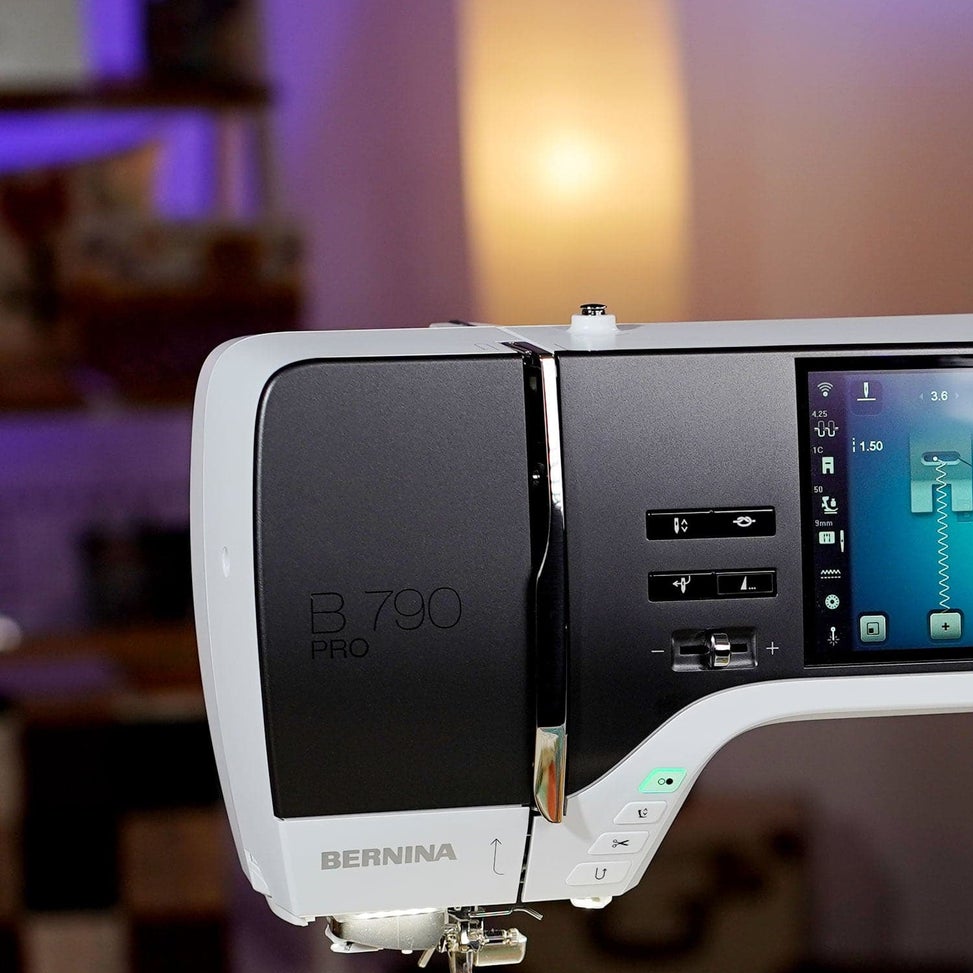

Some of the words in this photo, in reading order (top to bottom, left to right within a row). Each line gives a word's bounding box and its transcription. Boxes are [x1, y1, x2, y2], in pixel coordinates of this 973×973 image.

[930, 390, 949, 401] 3.6
[812, 410, 828, 418] 4.25
[812, 446, 824, 454] 1C
[860, 440, 883, 451] 1.50
[815, 519, 833, 527] 9mm
[310, 591, 346, 634] B
[364, 586, 462, 632] 790
[311, 637, 369, 659] PRO
[320, 842, 457, 870] BERNINA
